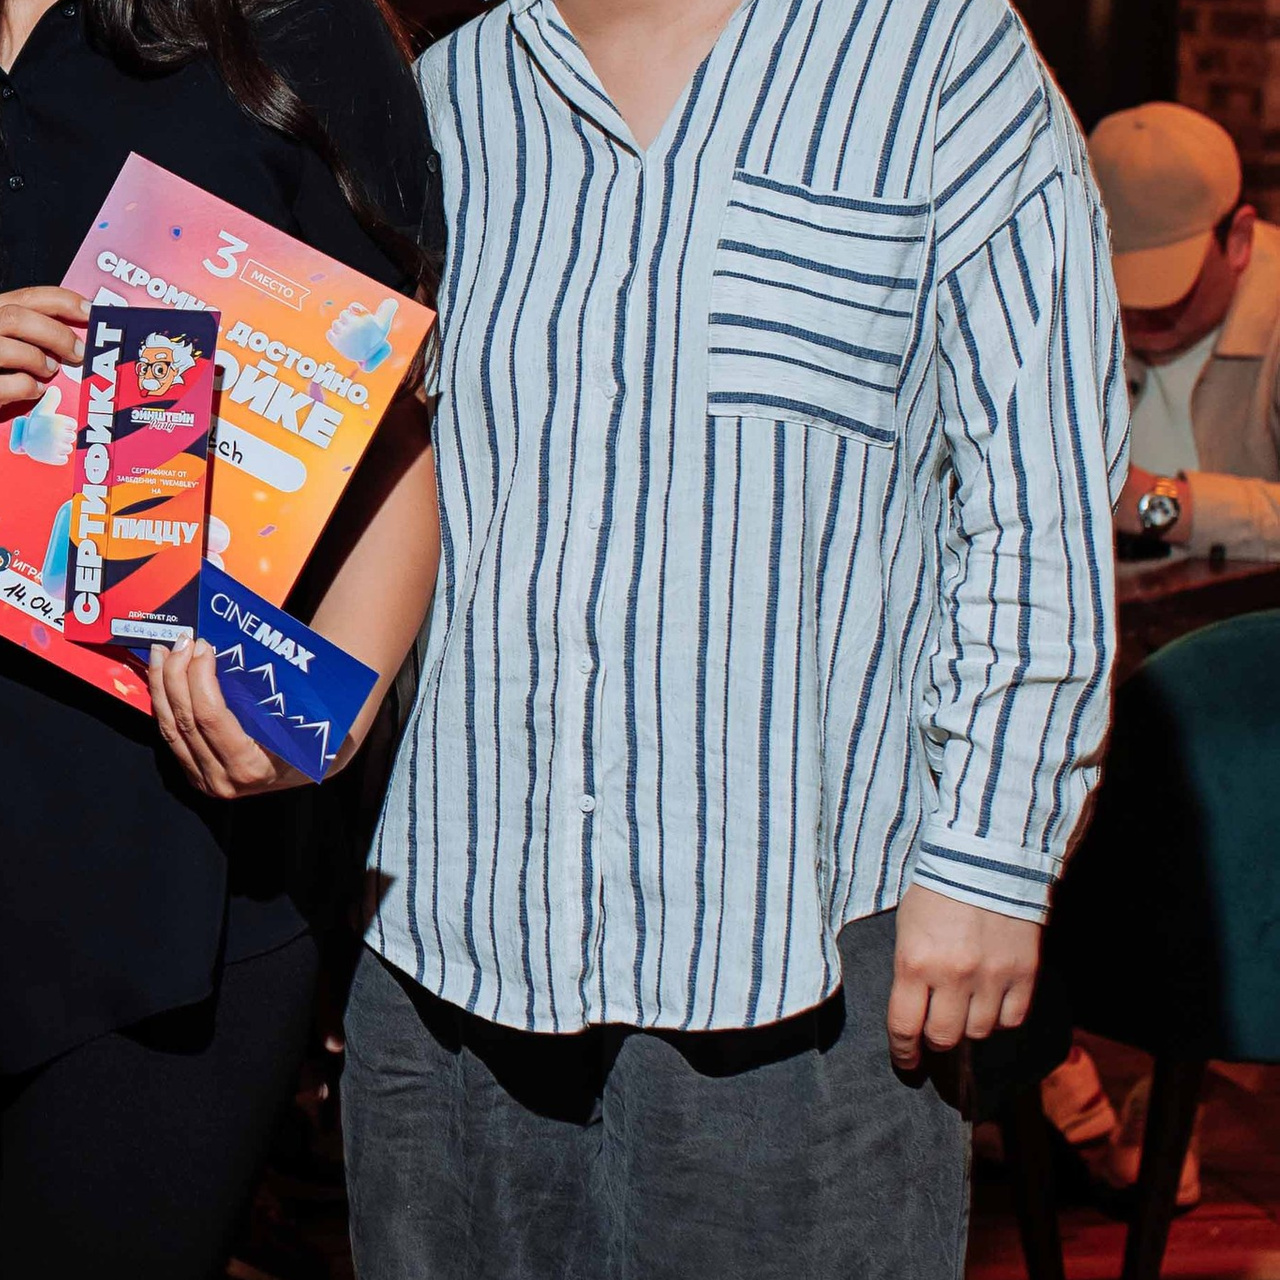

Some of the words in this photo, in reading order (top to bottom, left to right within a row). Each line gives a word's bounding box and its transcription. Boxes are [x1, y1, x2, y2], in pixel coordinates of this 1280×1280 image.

[203, 230, 249, 278] 3
[251, 270, 295, 299] МЕСТО
[226, 320, 370, 411] ДОСТОЙНО.
[131, 408, 195, 425] ЭЙНШТЕЙН
[73, 322, 122, 625] СЕРТИФИКАТ
[116, 475, 157, 485] ЗАВЕДЕНИЯ
[160, 478, 200, 489] "WEMBLEY"
[131, 467, 176, 477] СЕРТИФИКАТ
[151, 487, 162, 495] НА
[112, 517, 200, 547] ПИЦЦУ
[128, 611, 166, 621] ДЕЙСТВУЕТ
[166, 614, 179, 623] ДО:
[210, 593, 317, 674] CINEMAX
